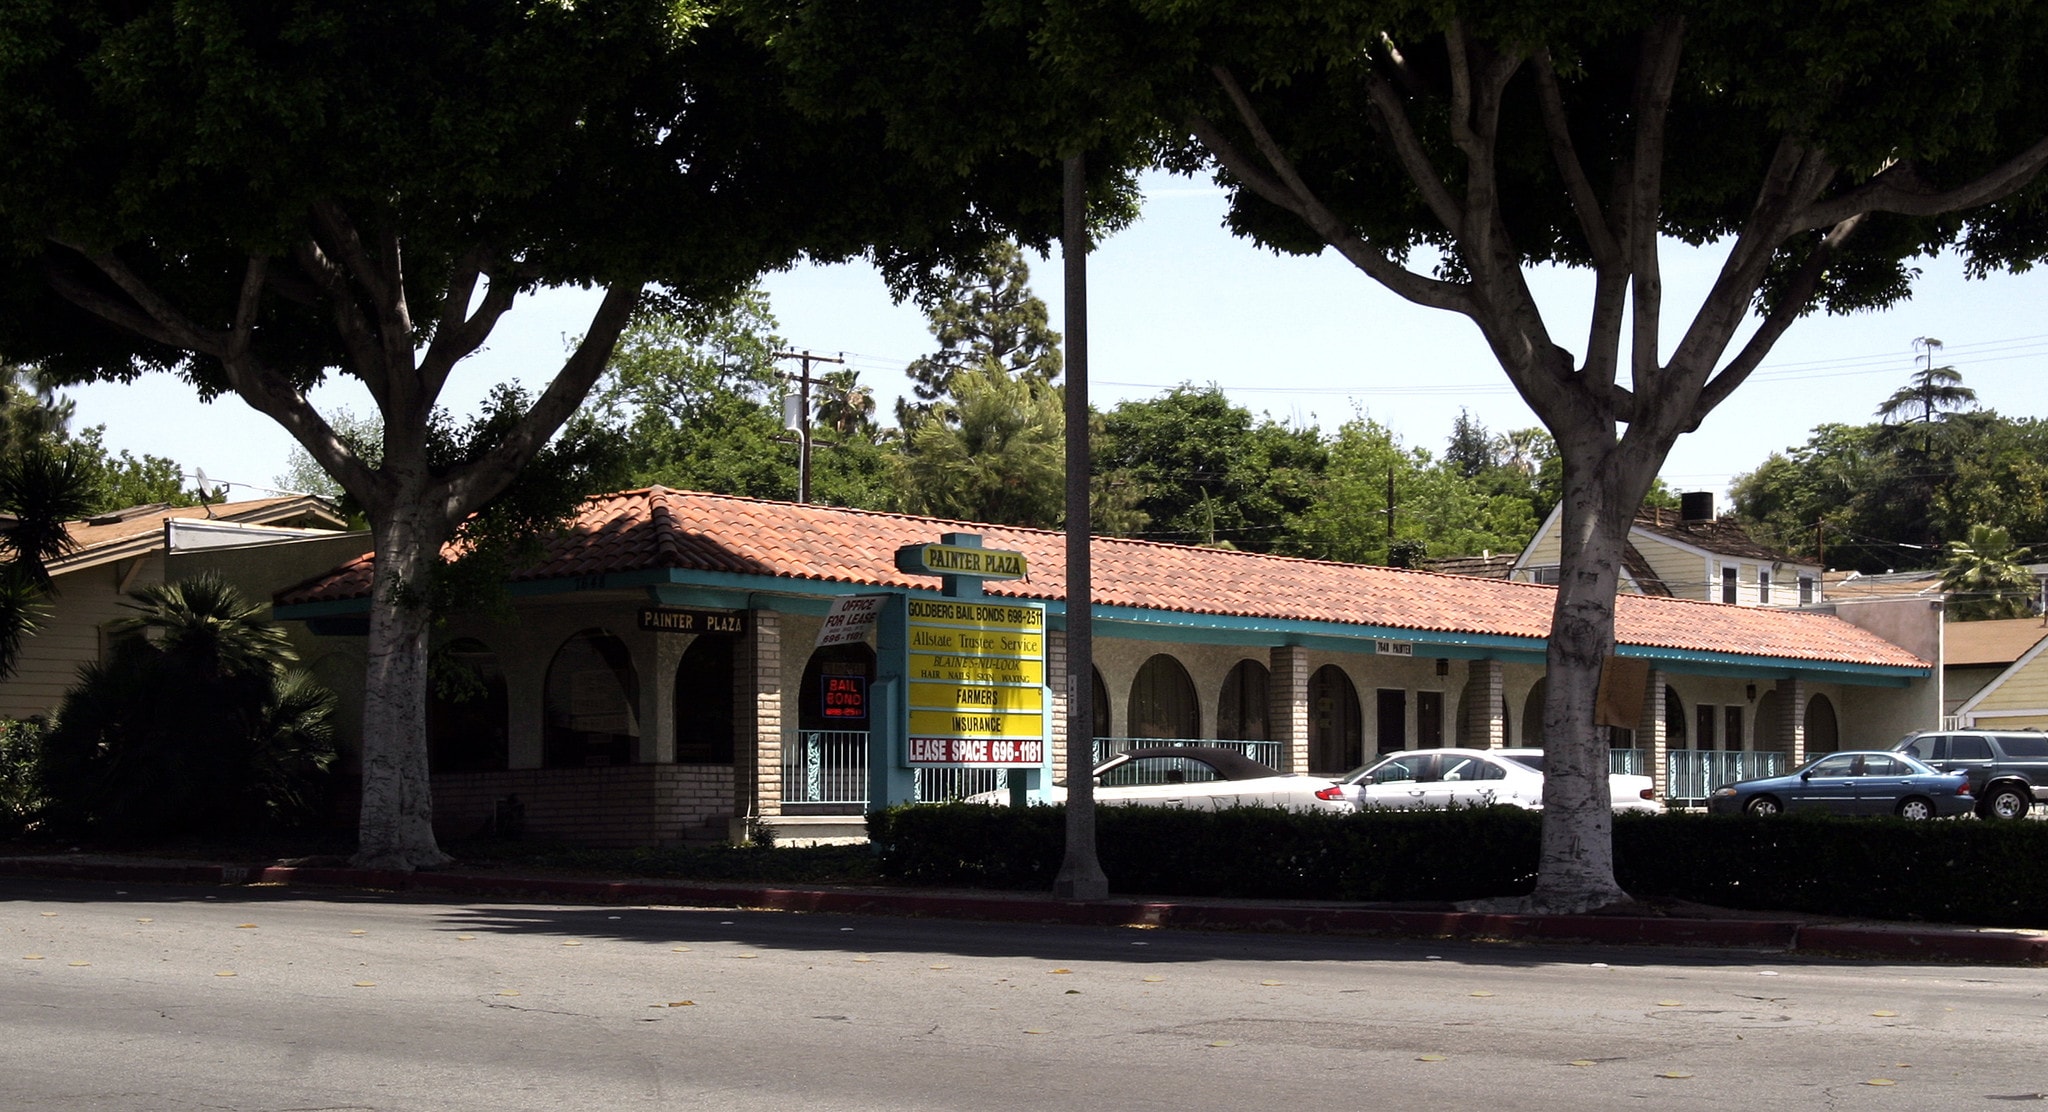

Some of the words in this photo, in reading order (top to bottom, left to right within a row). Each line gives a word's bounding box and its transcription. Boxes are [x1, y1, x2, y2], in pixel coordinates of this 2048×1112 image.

[929, 549, 980, 571] PAINTER
[985, 554, 1020, 574] PLAZA
[842, 599, 875, 611] OFFICE
[825, 615, 845, 627] FOR
[846, 612, 877, 625] LEASE
[908, 602, 954, 619] GOLDBERG
[956, 605, 974, 620] BAIL
[976, 607, 1004, 622] BONDS
[1007, 609, 1043, 625] 698-2511
[645, 612, 693, 629] PAINTER
[707, 616, 742, 632] PLAZA
[823, 632, 864, 643] 696-1181
[912, 631, 952, 647] Allstate
[959, 634, 994, 650] Trustee
[1001, 636, 1037, 652] Service
[921, 670, 941, 679] HAIR
[948, 671, 970, 680] NAILS
[976, 672, 994, 682] SKIN
[1001, 674, 1030, 684] WAXING
[829, 679, 858, 692] BAIL
[826, 692, 862, 706] BOND
[956, 689, 998, 705] FARMERS
[952, 717, 1001, 732] INSURANCE
[909, 740, 947, 761] LEASE
[952, 740, 988, 761] SPACE
[992, 741, 1042, 762] 696-1181
